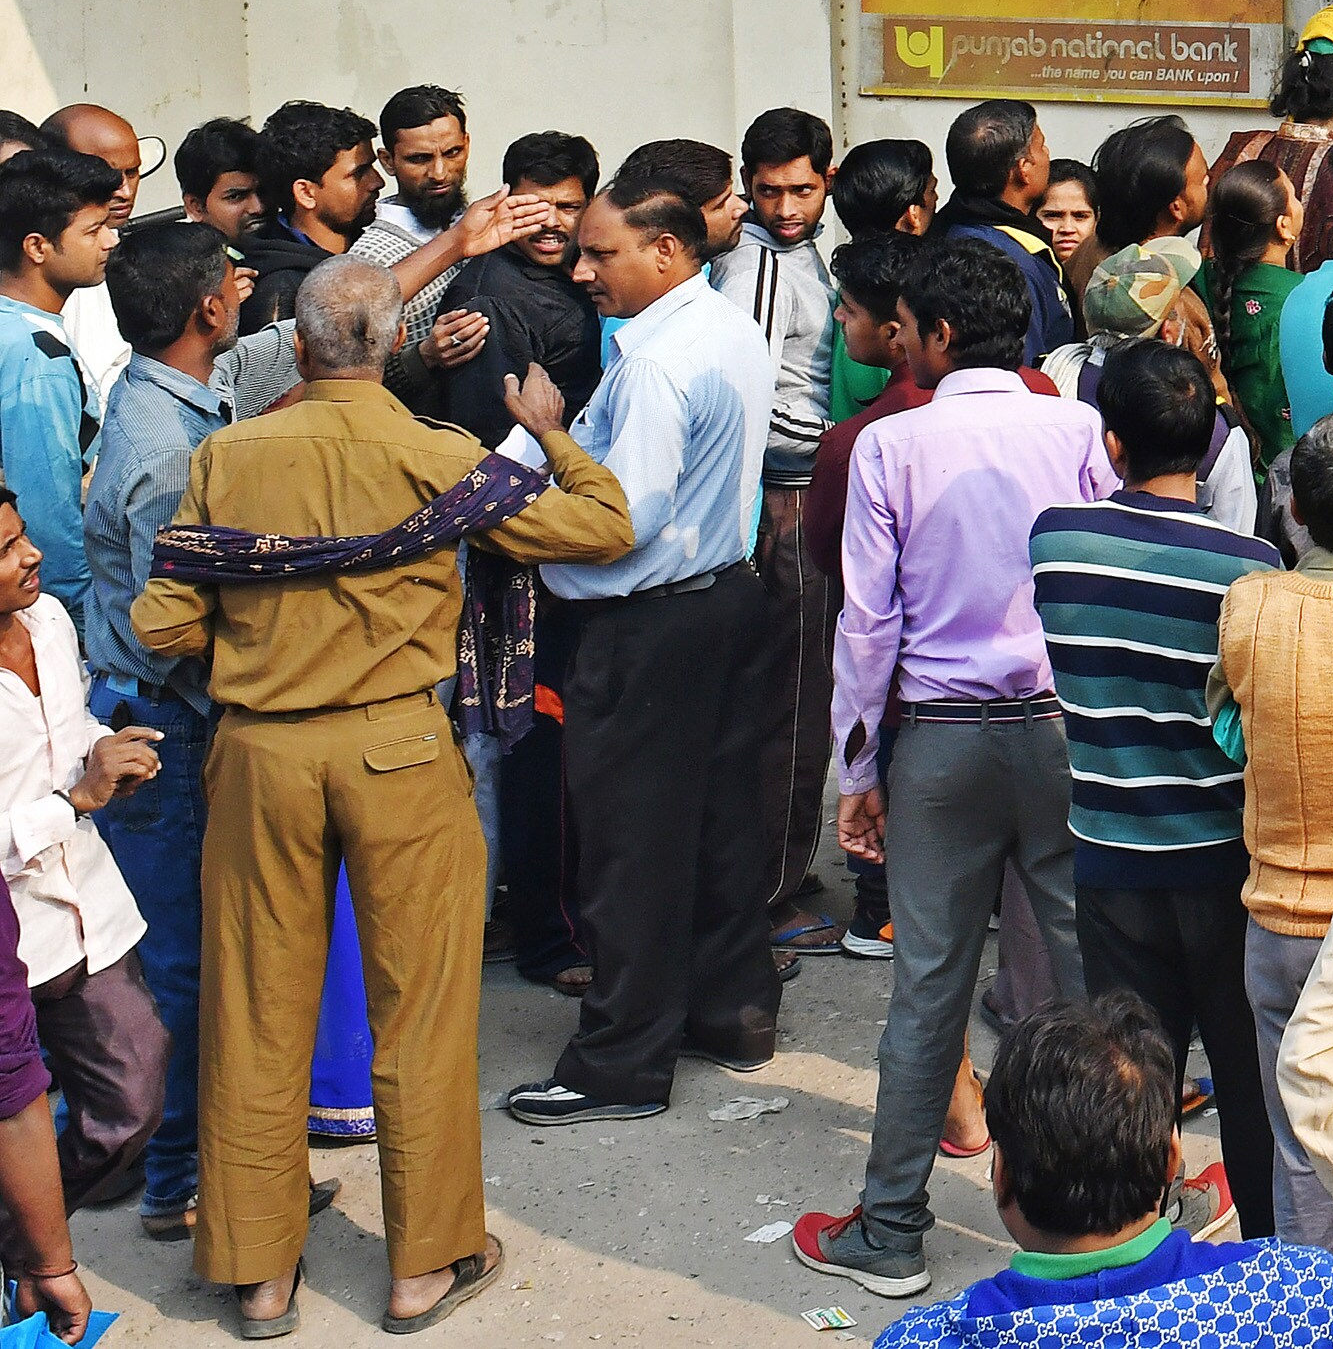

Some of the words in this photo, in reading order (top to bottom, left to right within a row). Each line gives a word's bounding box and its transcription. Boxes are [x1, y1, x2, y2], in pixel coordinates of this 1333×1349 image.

[953, 29, 1047, 66] punjab
[1051, 30, 1165, 61] national
[1171, 33, 1238, 63] bank
[1065, 67, 1100, 80] name
[1103, 69, 1127, 84] you
[1129, 70, 1152, 82] can
[1155, 69, 1194, 82] BANK
[1197, 71, 1231, 85] upon
